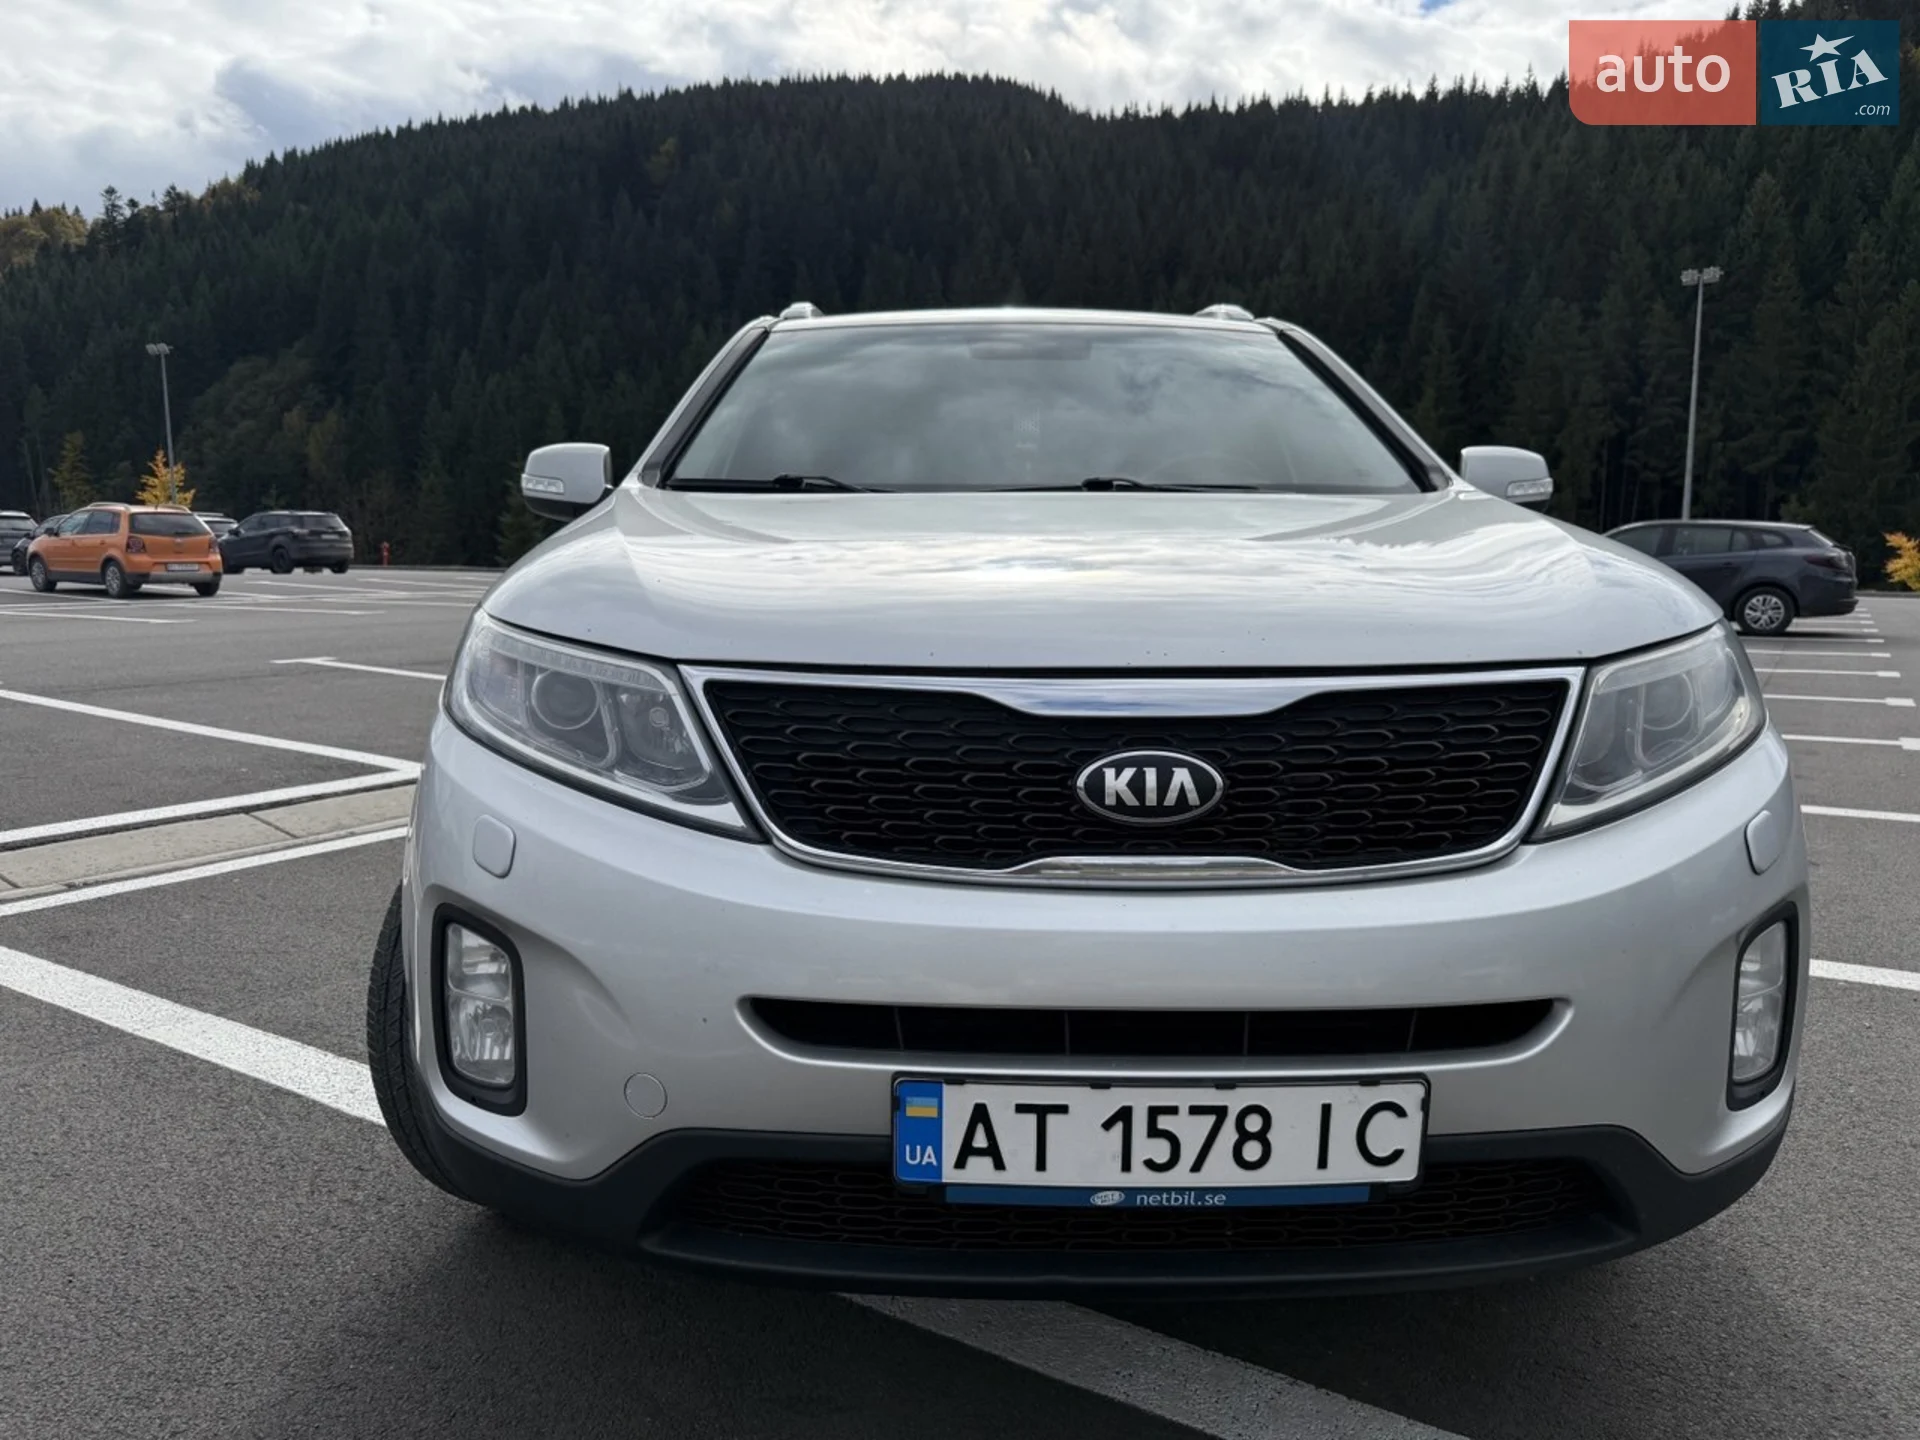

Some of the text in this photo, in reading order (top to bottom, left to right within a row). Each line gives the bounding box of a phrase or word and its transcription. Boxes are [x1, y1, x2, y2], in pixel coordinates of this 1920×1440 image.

[1102, 767, 1201, 806] KIA
[953, 1101, 1408, 1173] AT 1578 IC
[905, 1143, 938, 1166] UA
[1136, 1191, 1227, 1206] netbil.se
